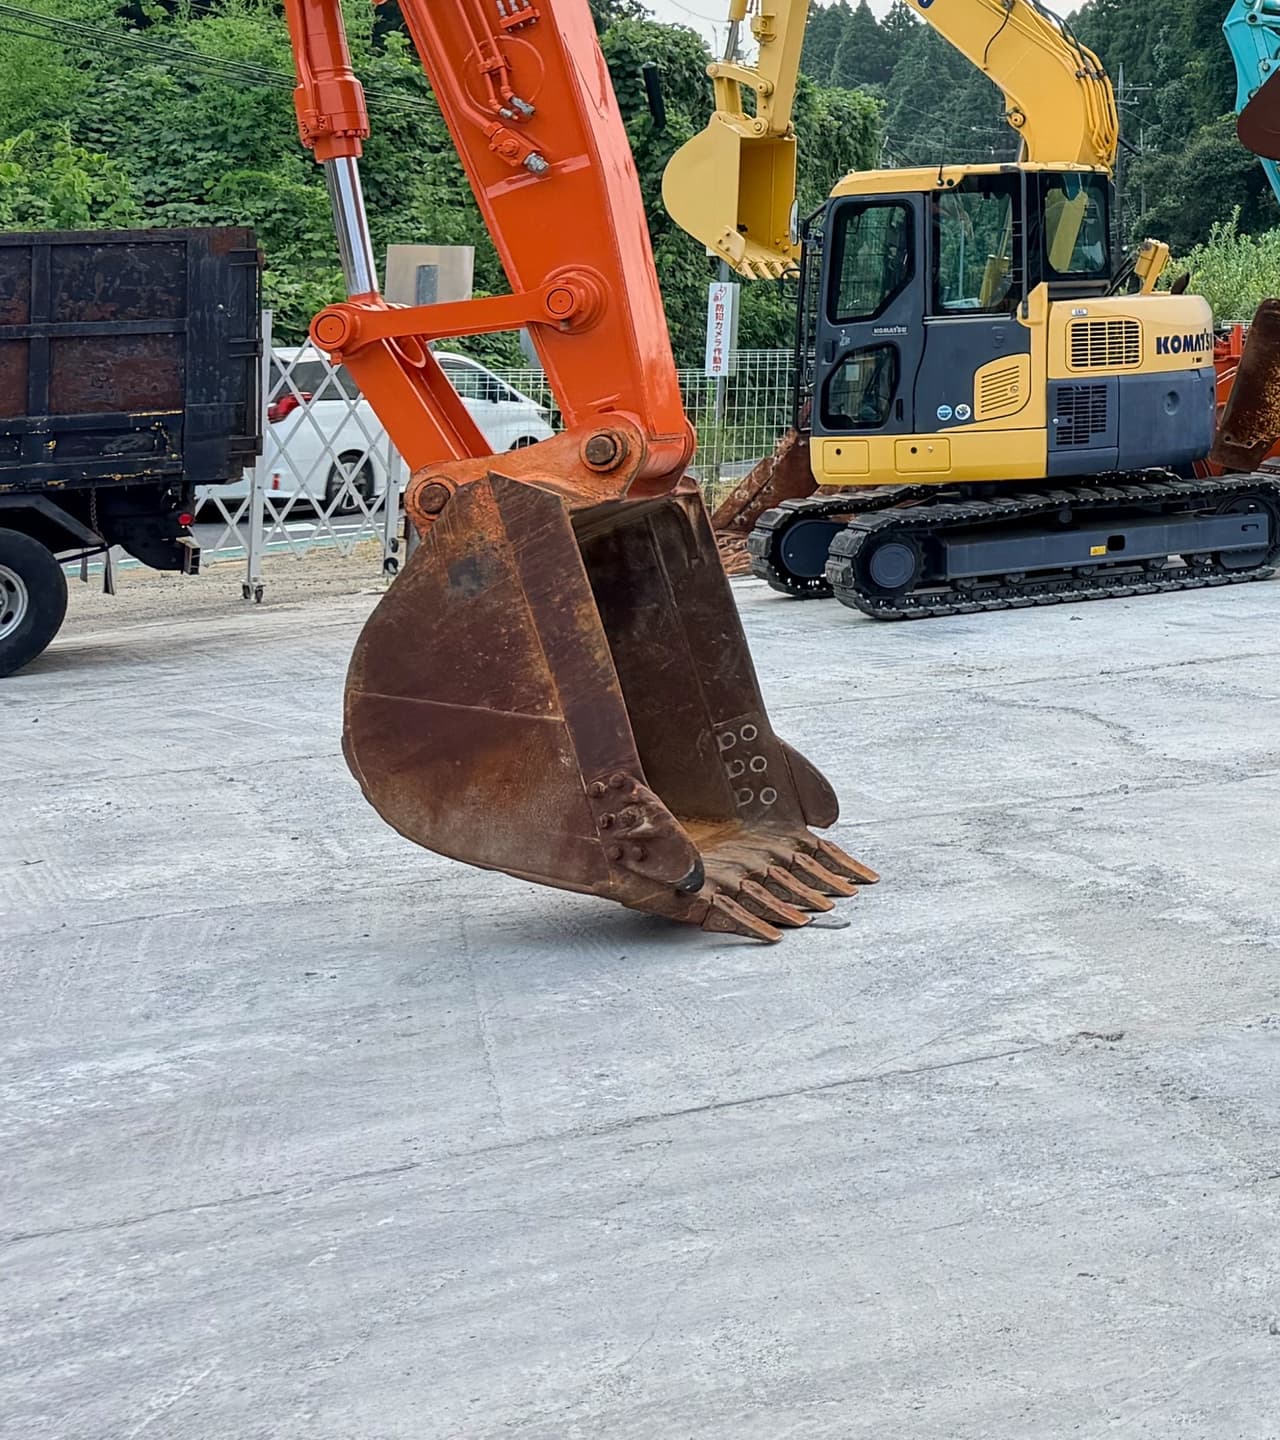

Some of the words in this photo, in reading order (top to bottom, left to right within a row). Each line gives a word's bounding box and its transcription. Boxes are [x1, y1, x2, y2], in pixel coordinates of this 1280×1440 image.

[713, 303, 725, 372] 防犯カメラ作動中
